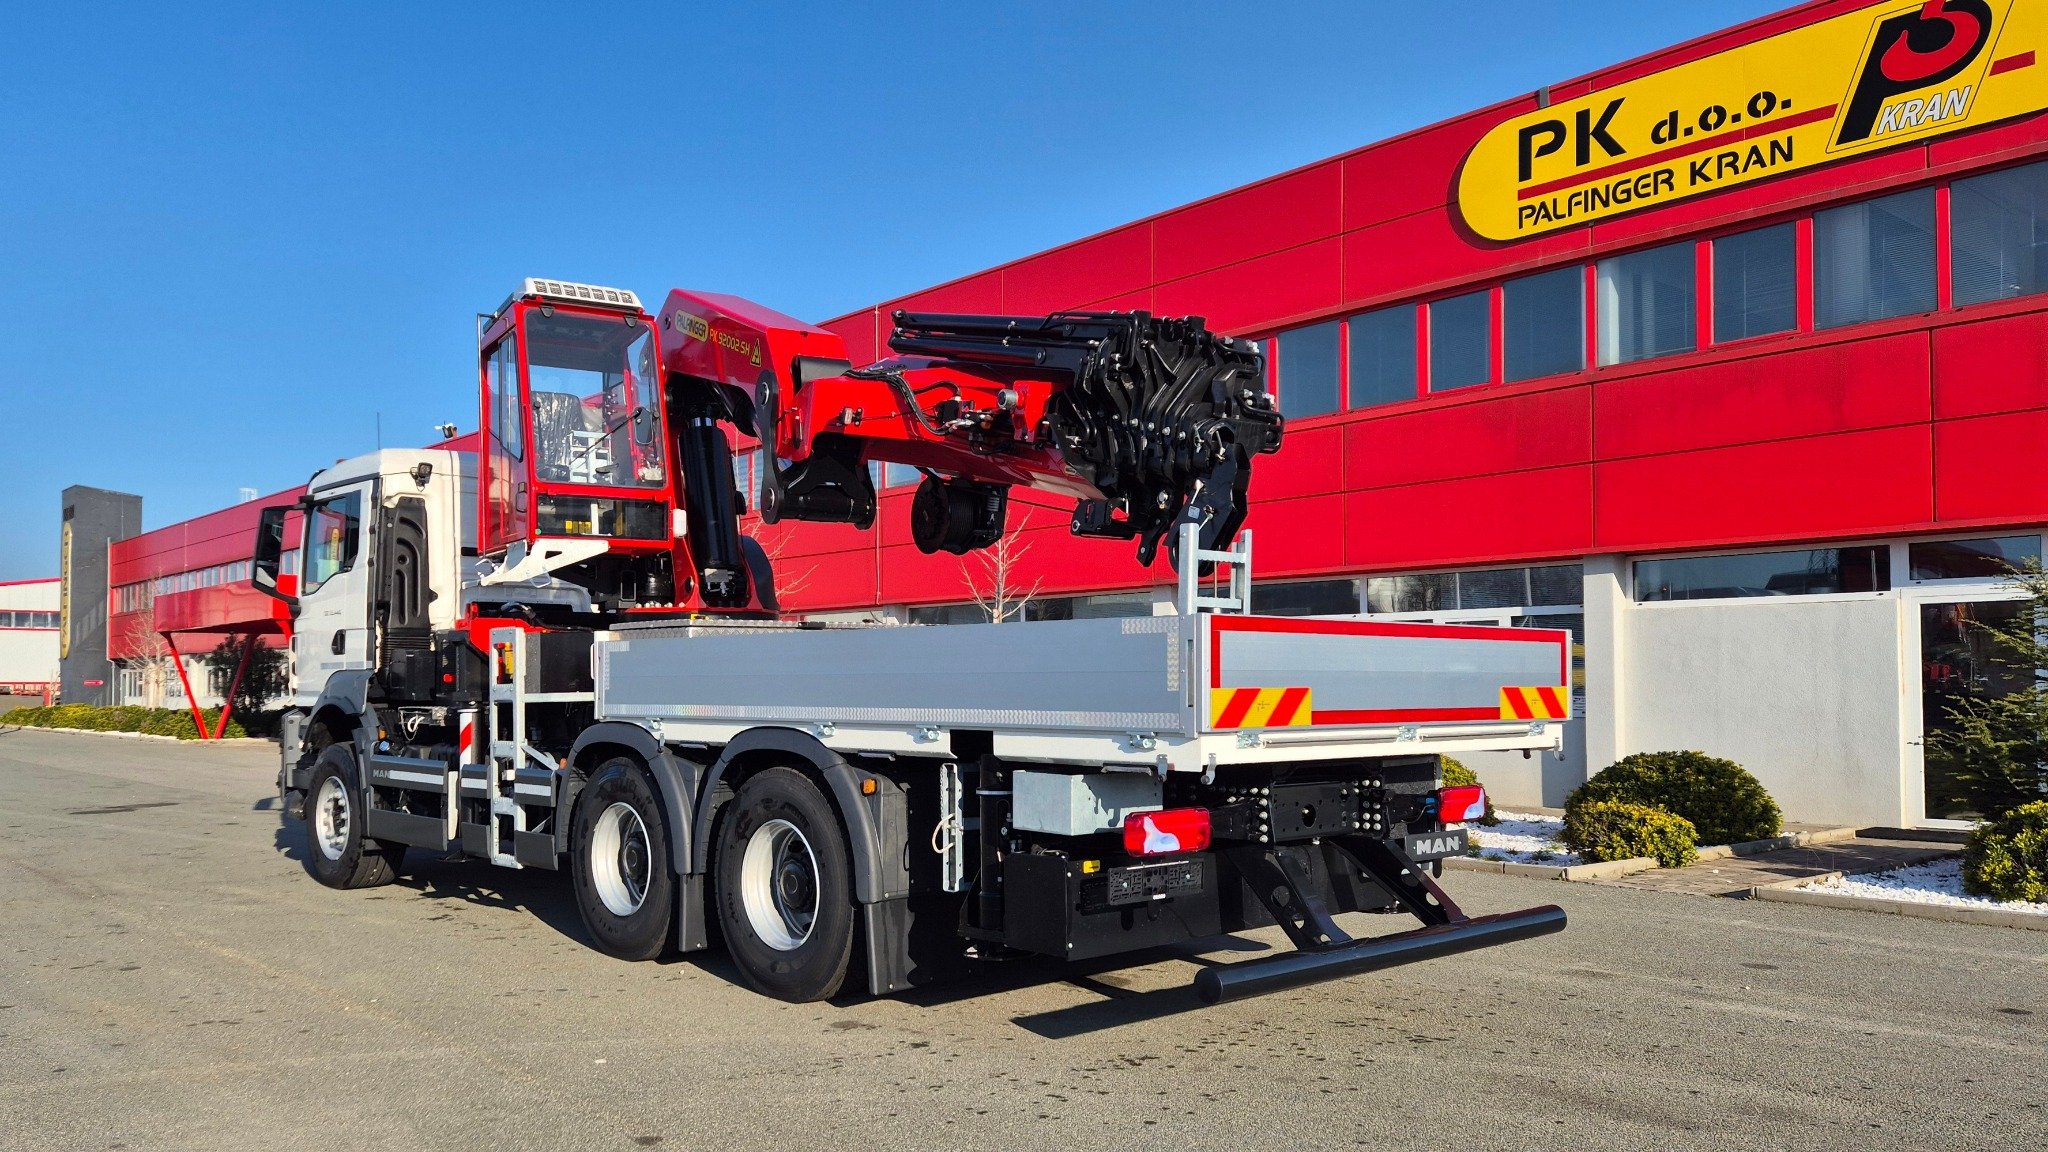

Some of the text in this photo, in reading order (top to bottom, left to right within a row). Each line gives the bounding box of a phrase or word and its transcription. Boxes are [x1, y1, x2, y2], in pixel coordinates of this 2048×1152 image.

[1876, 85, 1972, 135] KRAN
[1518, 91, 1792, 183] PK d.o.o.
[1518, 135, 1793, 230] PALFINGER KRAN
[677, 314, 706, 338] PALFINGER
[709, 328, 719, 343] PK
[718, 332, 740, 352] 92002
[1416, 836, 1459, 855] MAN
